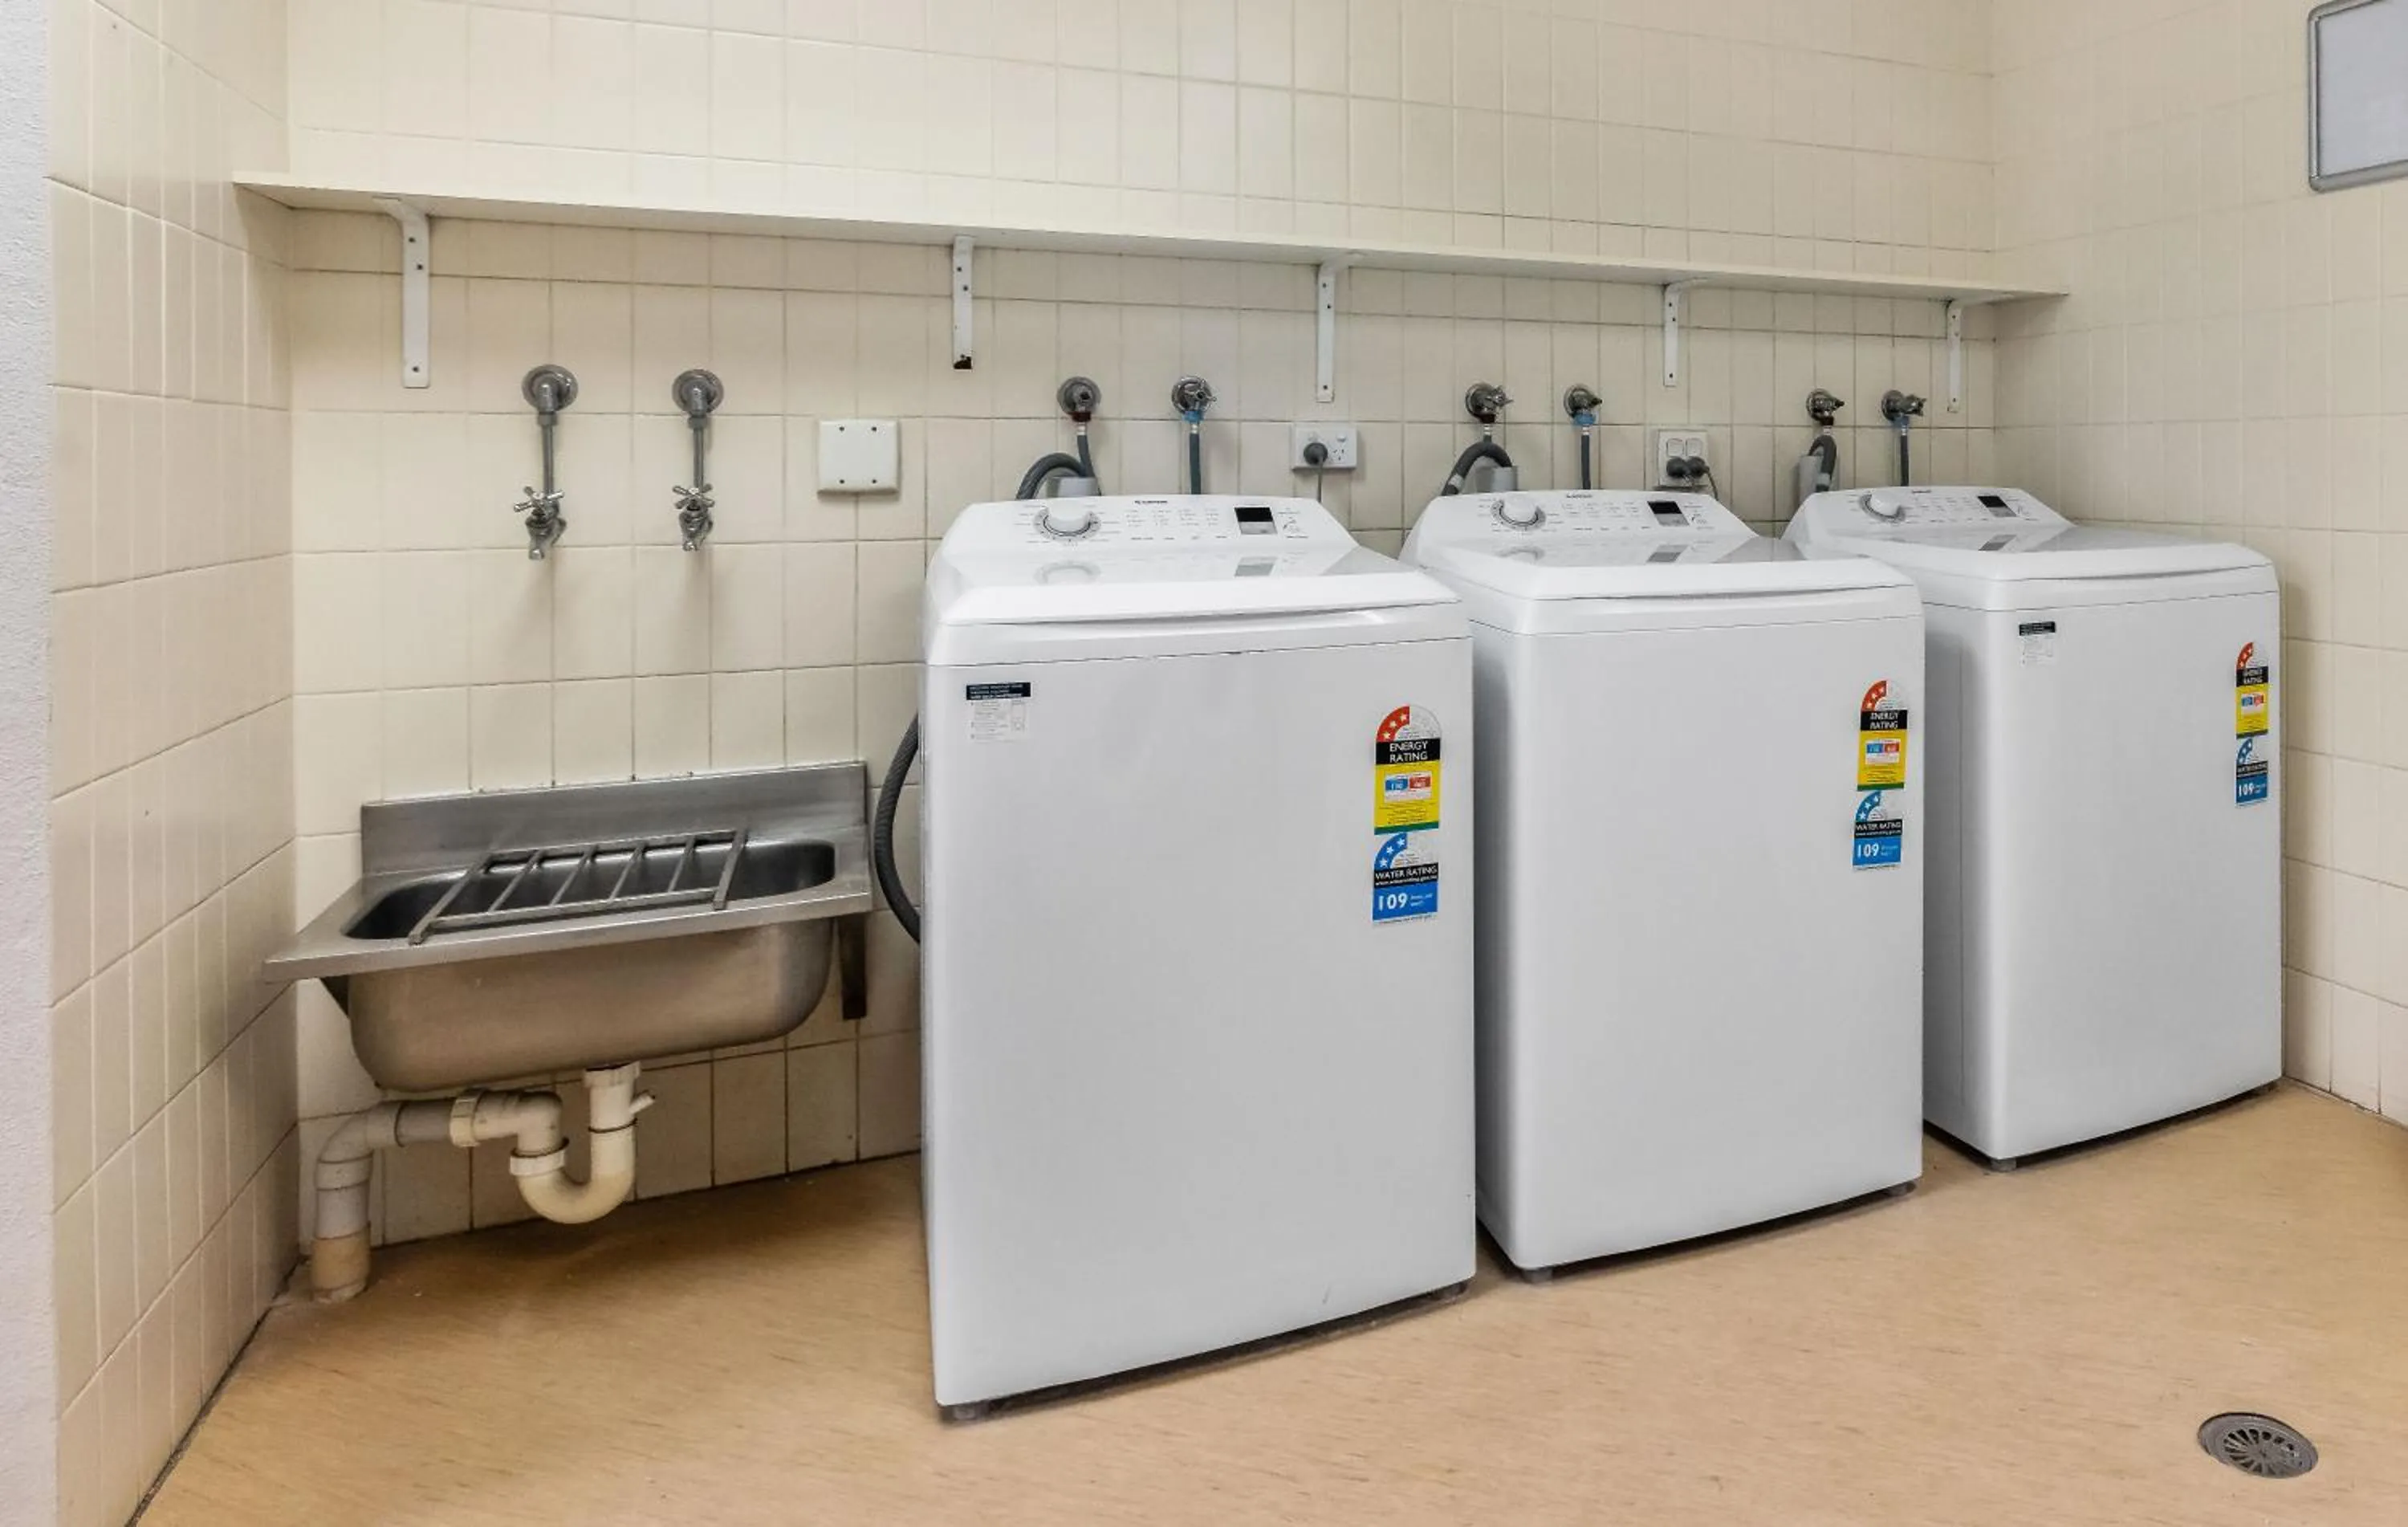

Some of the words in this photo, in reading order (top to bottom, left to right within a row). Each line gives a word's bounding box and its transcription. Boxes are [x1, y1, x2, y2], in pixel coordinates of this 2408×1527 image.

[1389, 741, 1428, 752] ENERGY
[1389, 751, 1428, 763] RATING
[1857, 842, 1879, 858] 109
[1375, 869, 1405, 881] WATER
[1406, 865, 1437, 877] RATING
[1378, 893, 1408, 911] 109
